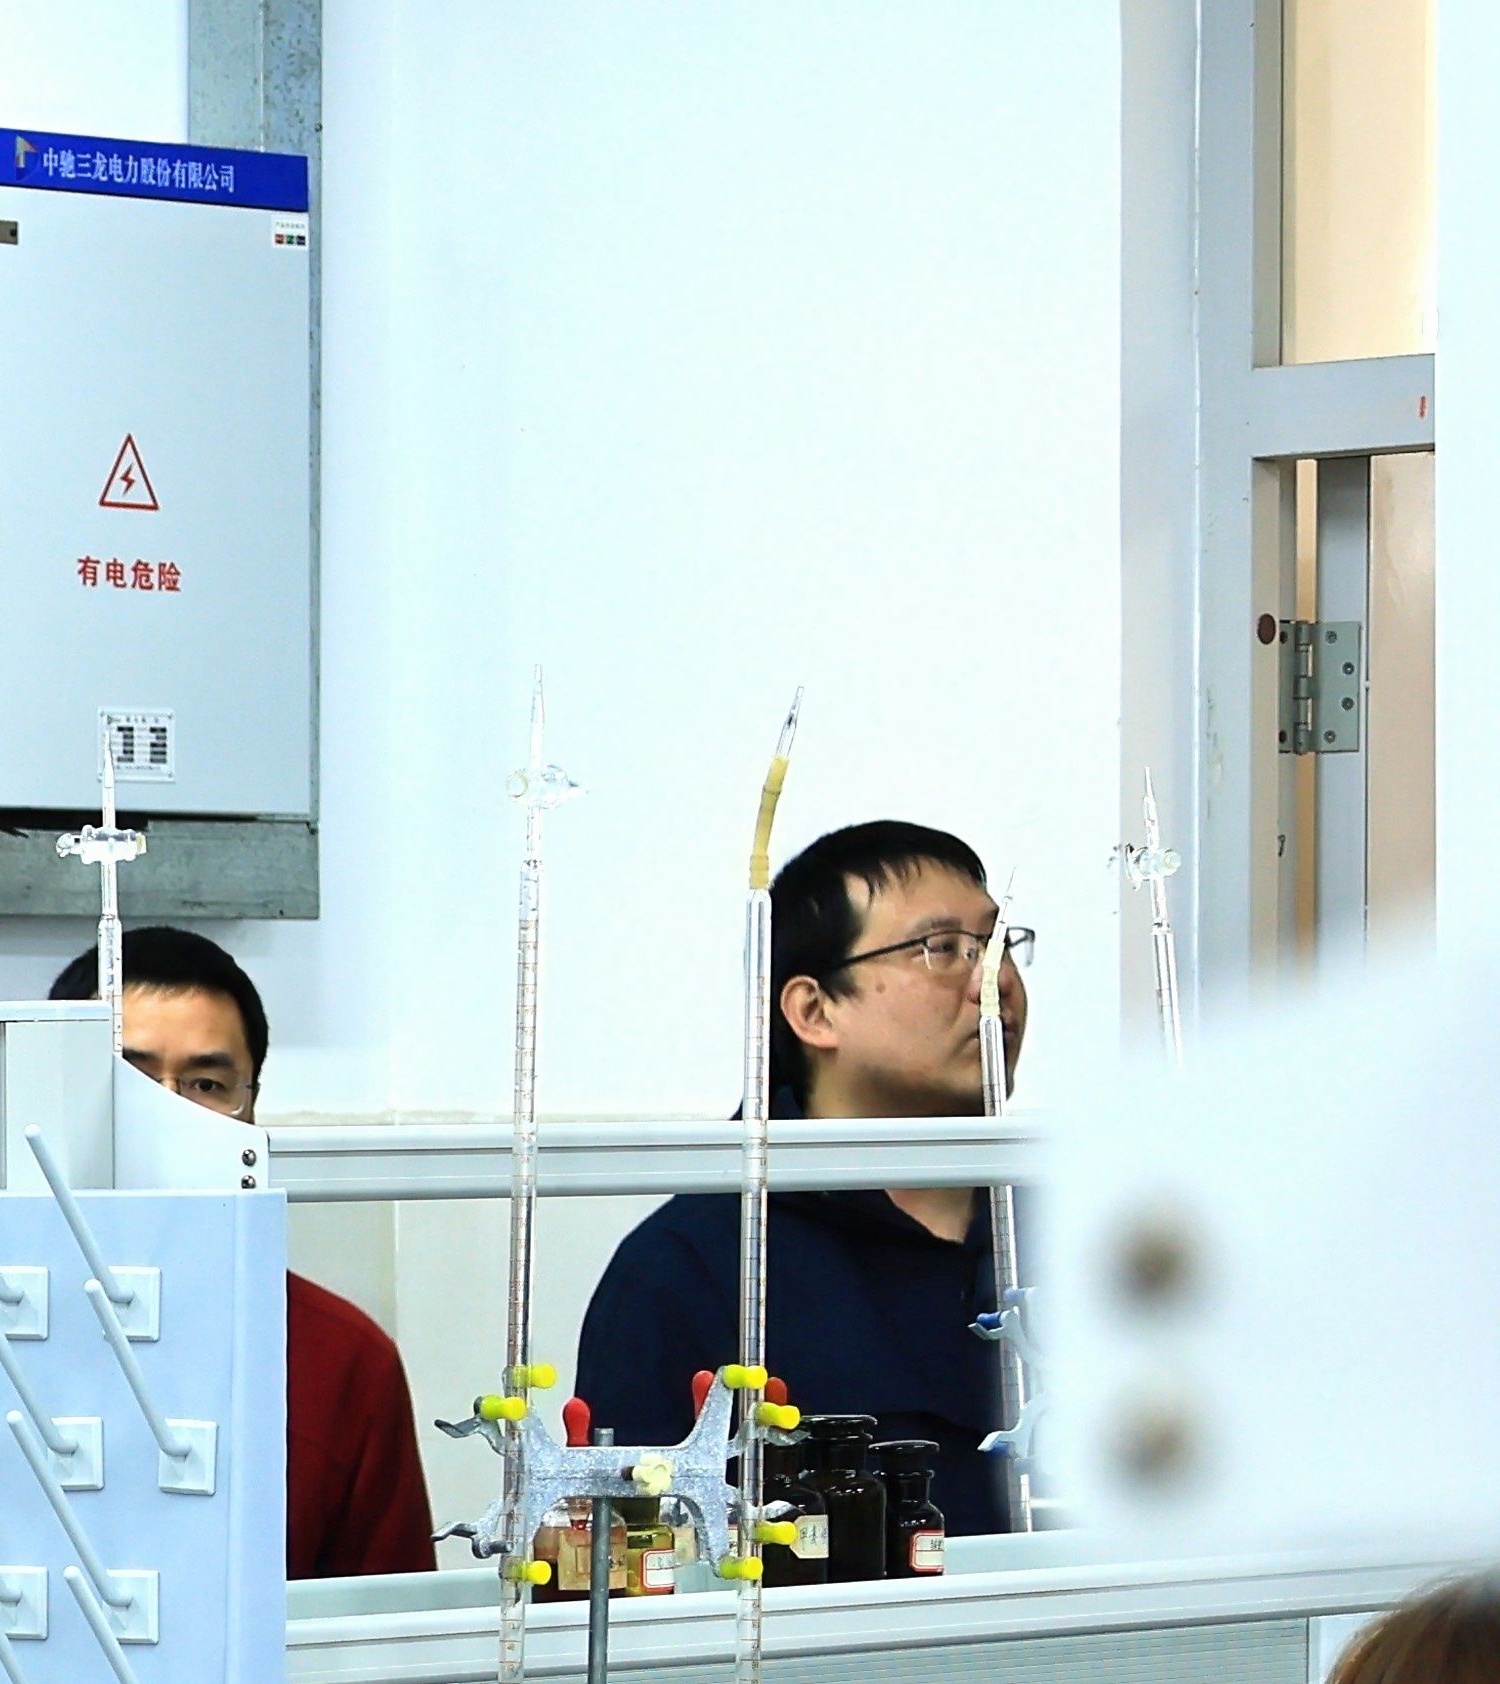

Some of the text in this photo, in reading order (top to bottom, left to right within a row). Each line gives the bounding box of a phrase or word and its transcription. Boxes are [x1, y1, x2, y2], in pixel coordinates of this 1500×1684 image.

[43, 147, 235, 193] 中驰三龙电力股份有限公司
[77, 556, 182, 592] 有电危险
